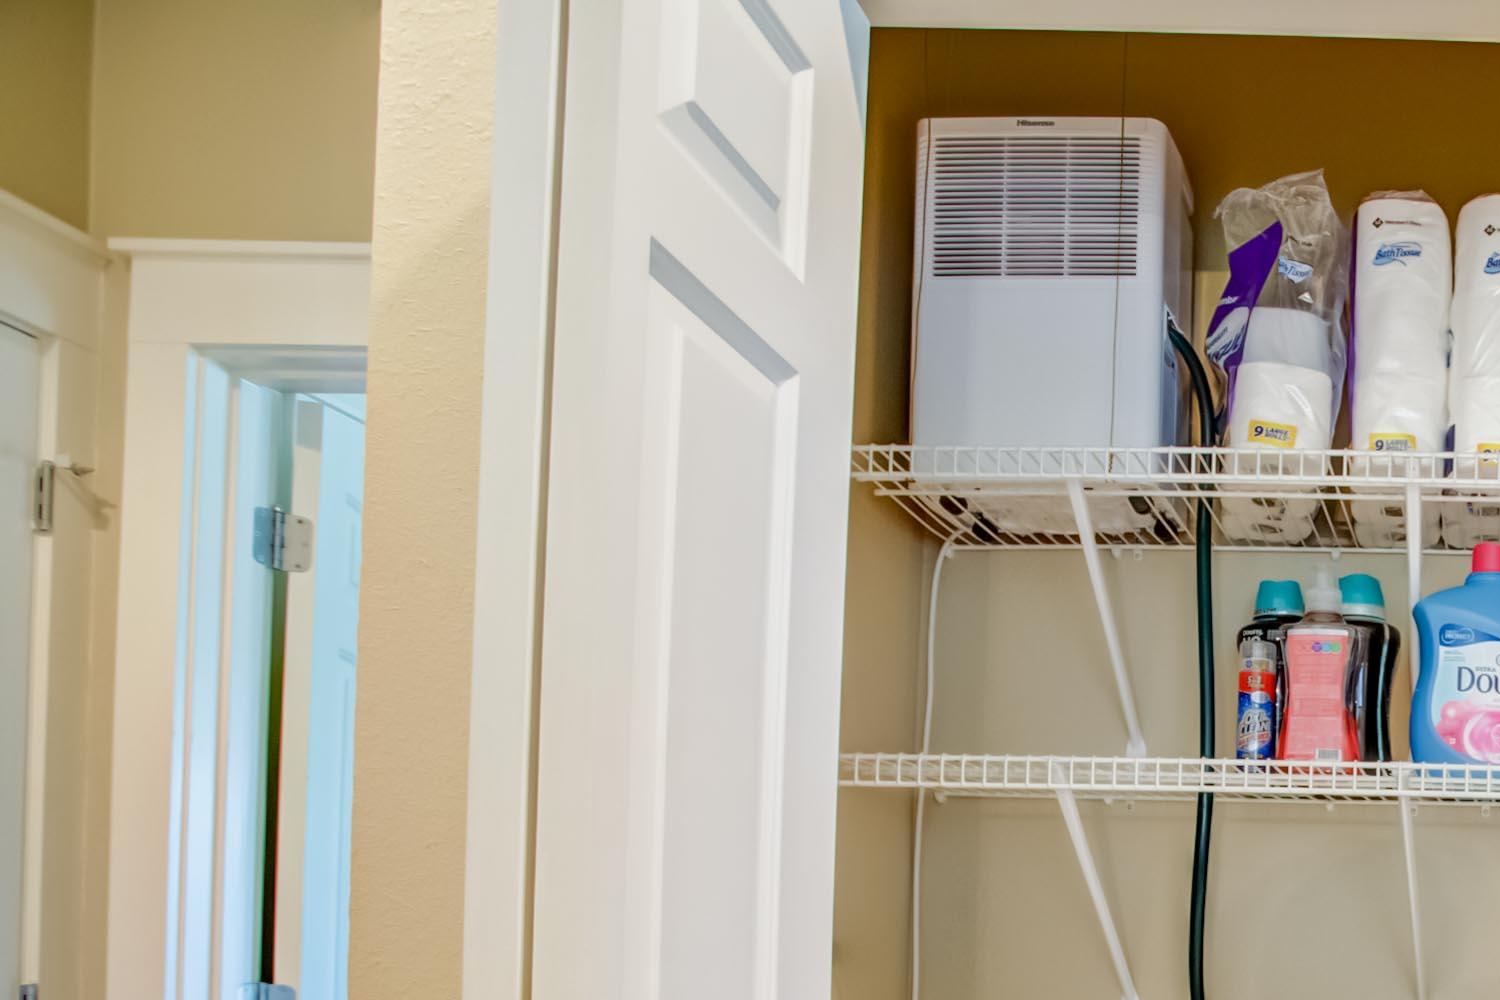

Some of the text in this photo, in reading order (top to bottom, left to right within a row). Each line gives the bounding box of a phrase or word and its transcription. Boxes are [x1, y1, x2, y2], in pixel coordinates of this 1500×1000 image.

[1376, 247, 1397, 260] Bath
[1253, 425, 1264, 437] 9
[1374, 439, 1384, 451] 9
